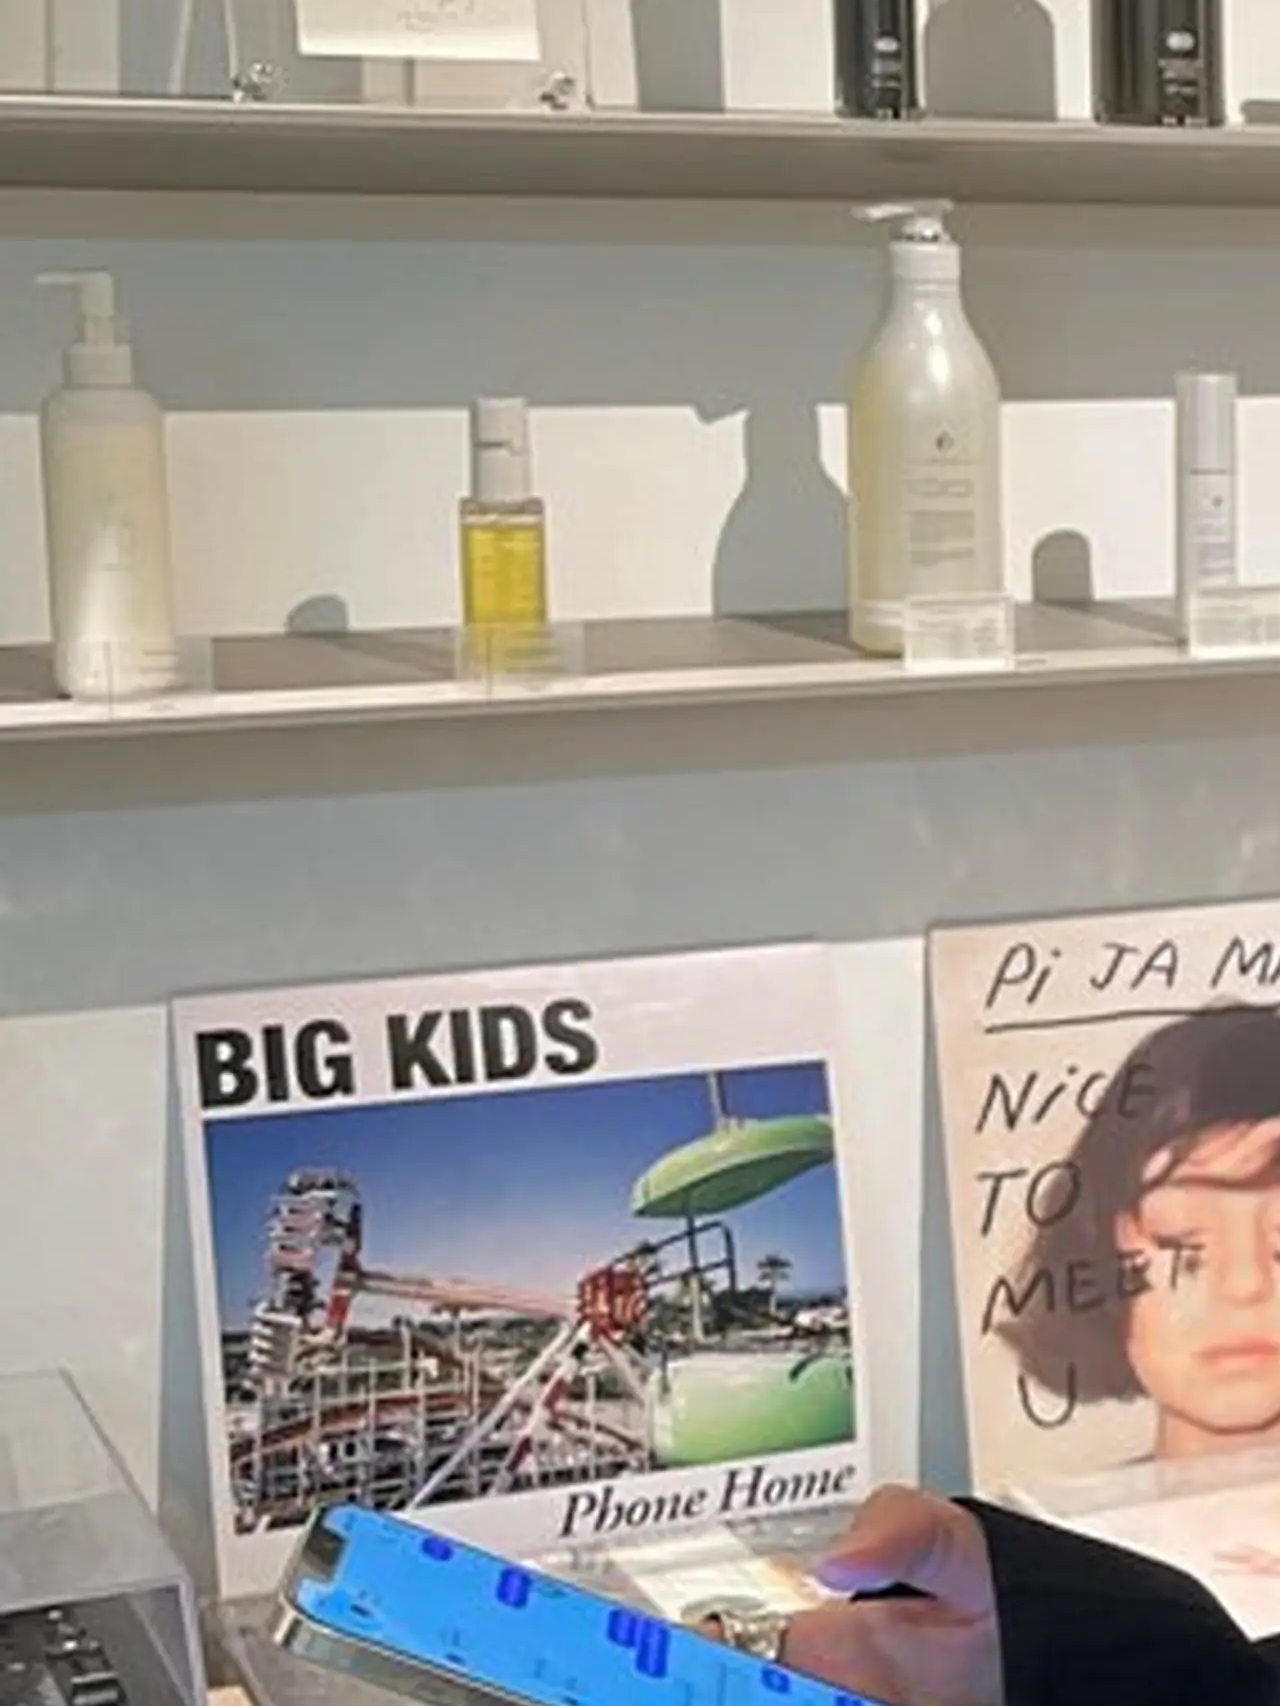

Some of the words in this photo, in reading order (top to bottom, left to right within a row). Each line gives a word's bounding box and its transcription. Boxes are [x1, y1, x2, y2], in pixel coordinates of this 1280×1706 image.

[985, 941, 1062, 1008] Pi
[1090, 938, 1179, 990] JA
[195, 1019, 356, 1110] BIG
[386, 999, 599, 1091] KIDS
[976, 1161, 1080, 1237] TO
[981, 1237, 1206, 1337] MEET
[1018, 1362, 1078, 1429] U
[560, 1485, 709, 1537] Phone
[718, 1464, 858, 1515] Home
